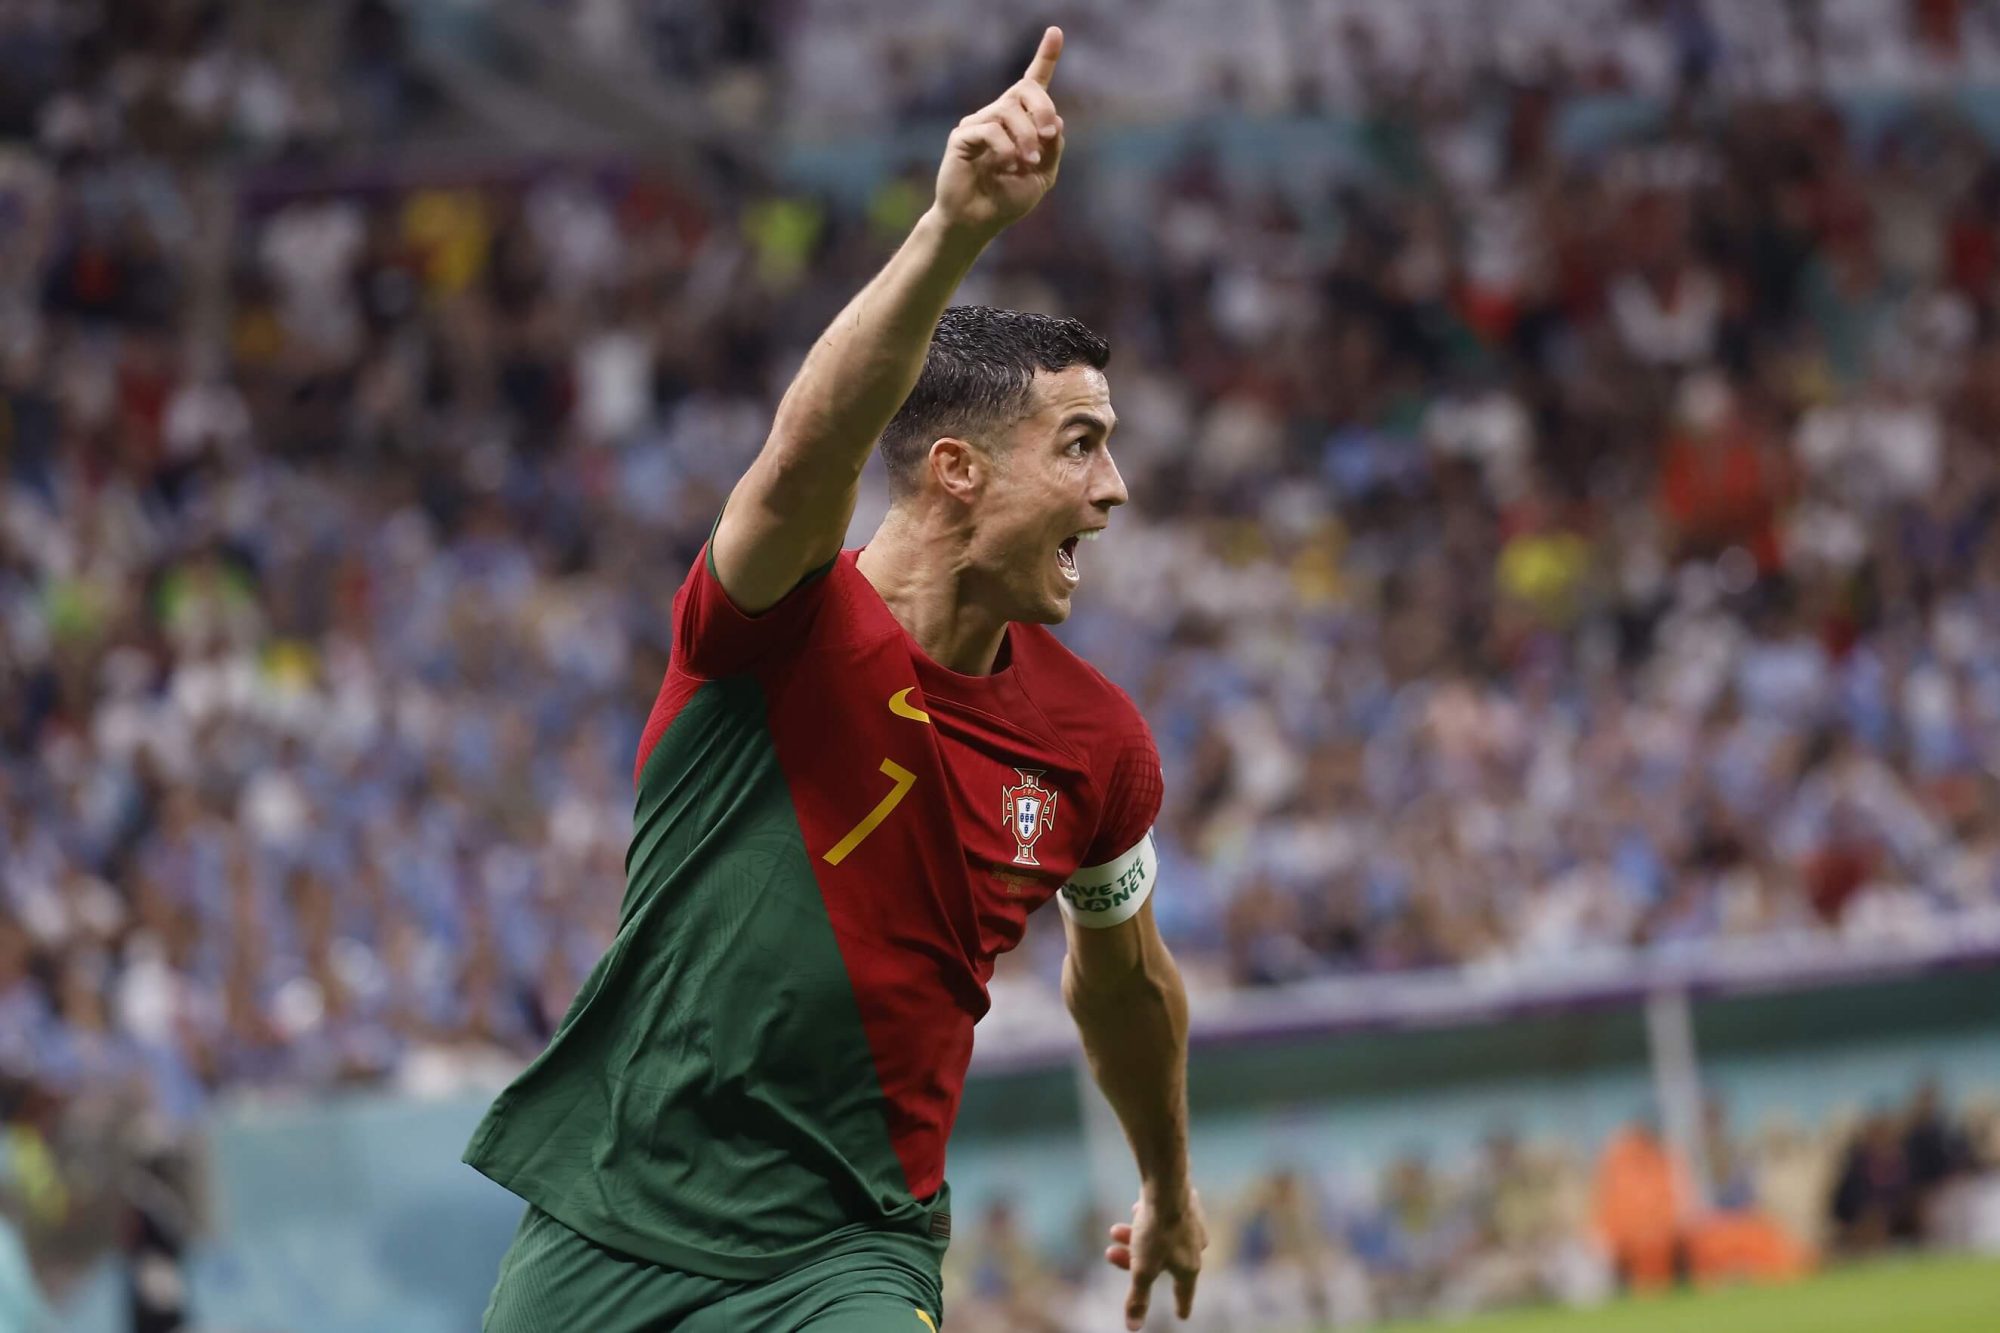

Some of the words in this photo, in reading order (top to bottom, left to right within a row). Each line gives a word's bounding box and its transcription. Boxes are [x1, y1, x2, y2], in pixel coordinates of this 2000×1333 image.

[822, 758, 917, 866] 7
[1064, 882, 1112, 897] AVE
[1117, 856, 1141, 886] THE
